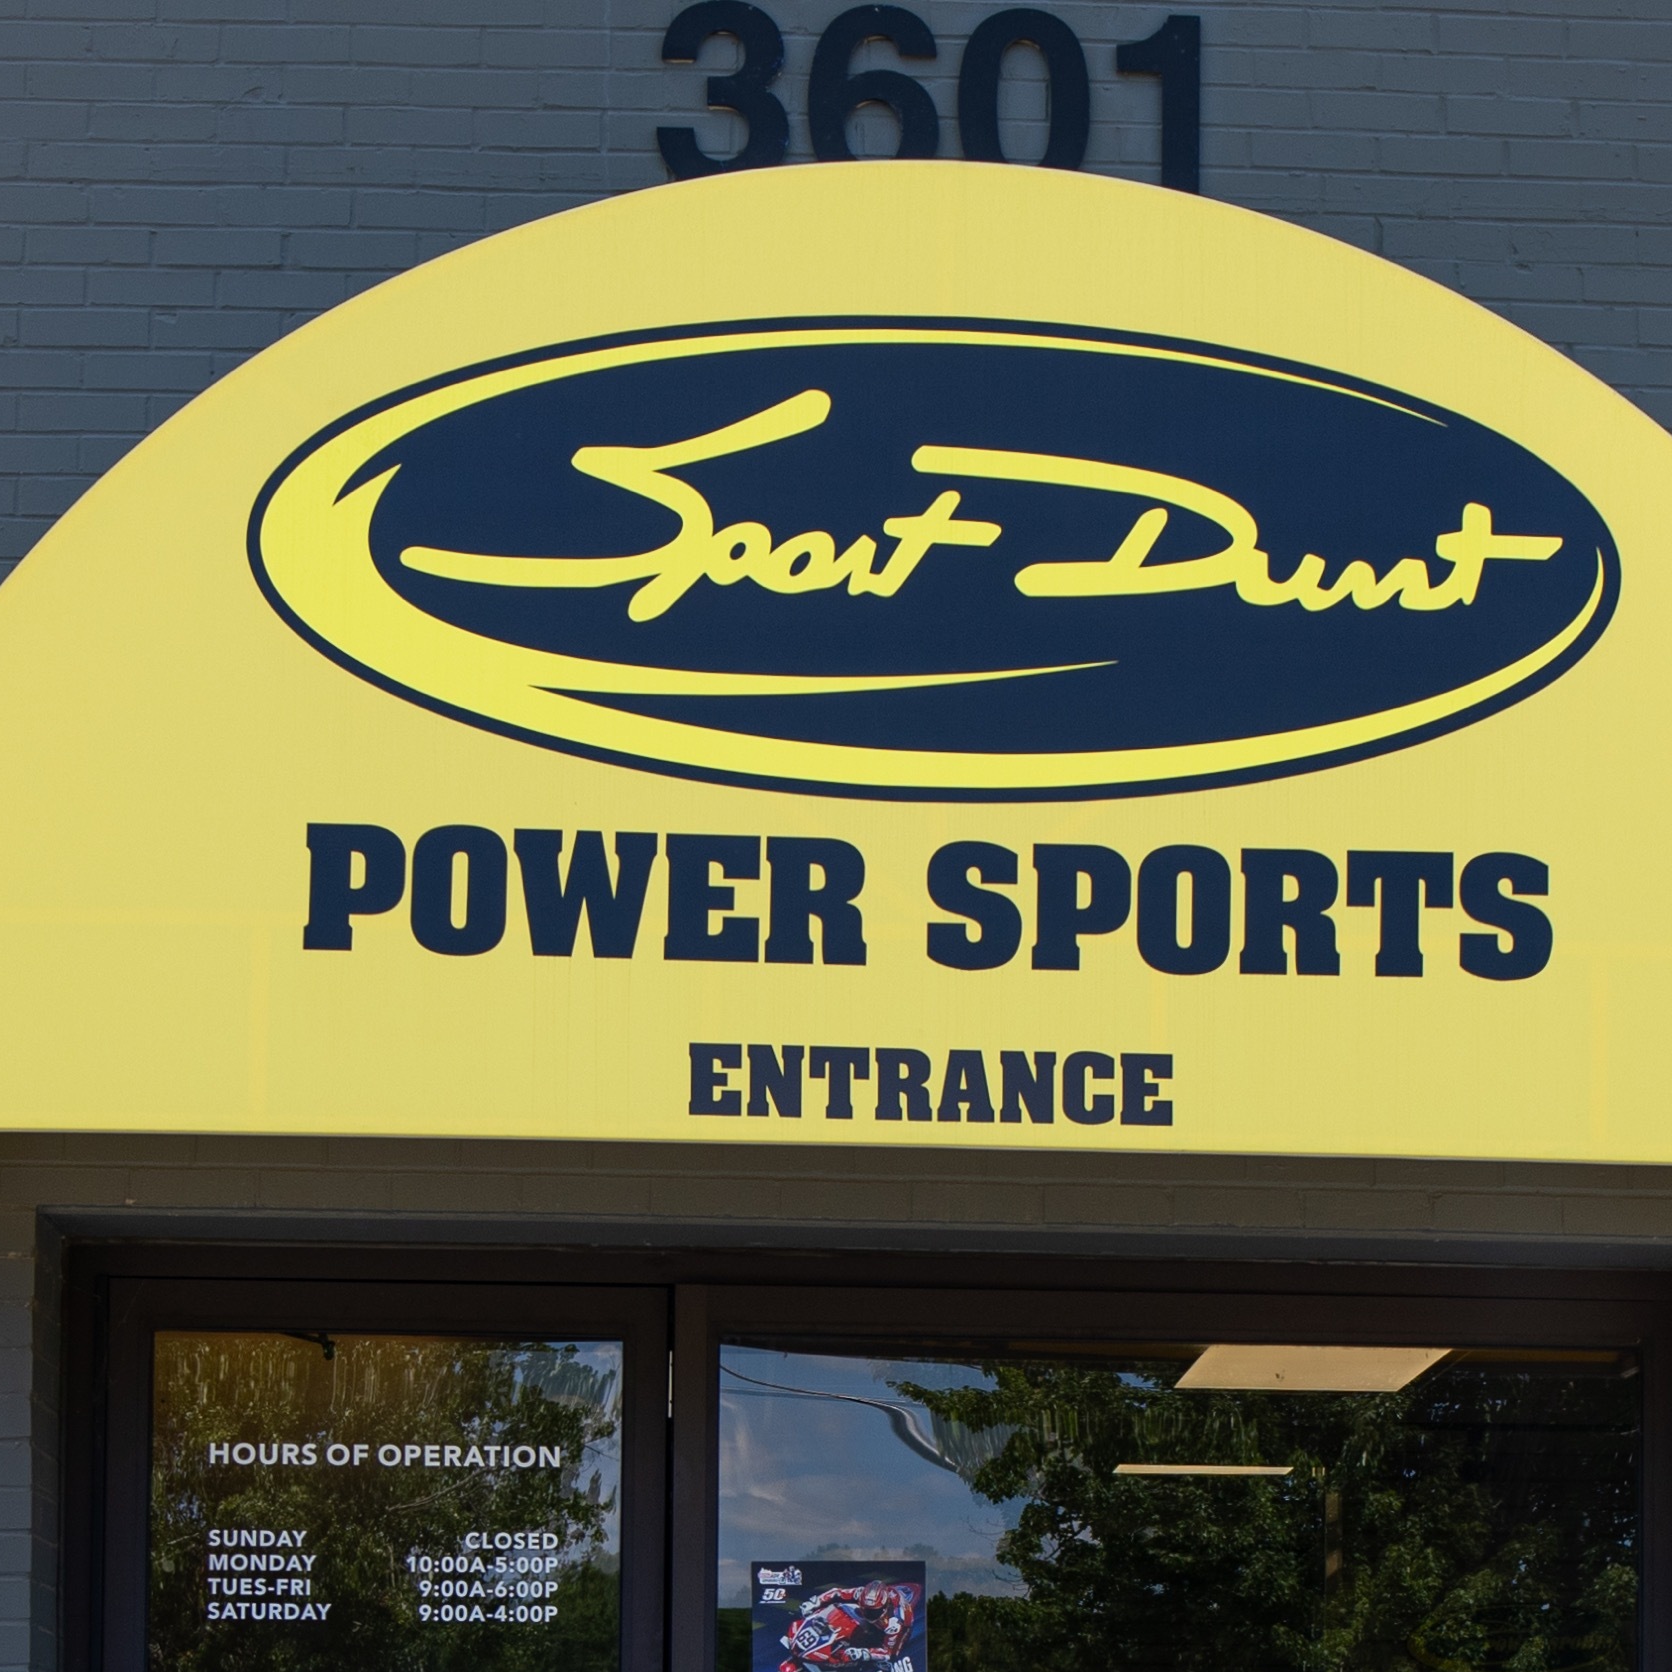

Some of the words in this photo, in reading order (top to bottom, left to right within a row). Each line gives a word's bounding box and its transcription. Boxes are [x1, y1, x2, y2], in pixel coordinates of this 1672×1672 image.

[656, 0, 1202, 196] 3601
[398, 388, 1002, 623] Sport
[302, 822, 867, 966] POWER
[926, 840, 1553, 982] SPORTS
[688, 1042, 1174, 1127] ENTRANCE
[208, 1442, 318, 1466] HOURS
[326, 1443, 370, 1466] OF
[377, 1444, 561, 1469] OPERATION
[207, 1529, 308, 1548] SUNDAY
[464, 1532, 559, 1550] CLOSED
[207, 1553, 317, 1572] MONDAY
[406, 1556, 559, 1574] 10:00A-5:00P
[207, 1577, 311, 1596] TUES-FRI
[418, 1580, 559, 1598] 9:00A-6:00P
[206, 1601, 332, 1621] SATURDAY
[418, 1604, 559, 1623] 9:00A-4:00P
